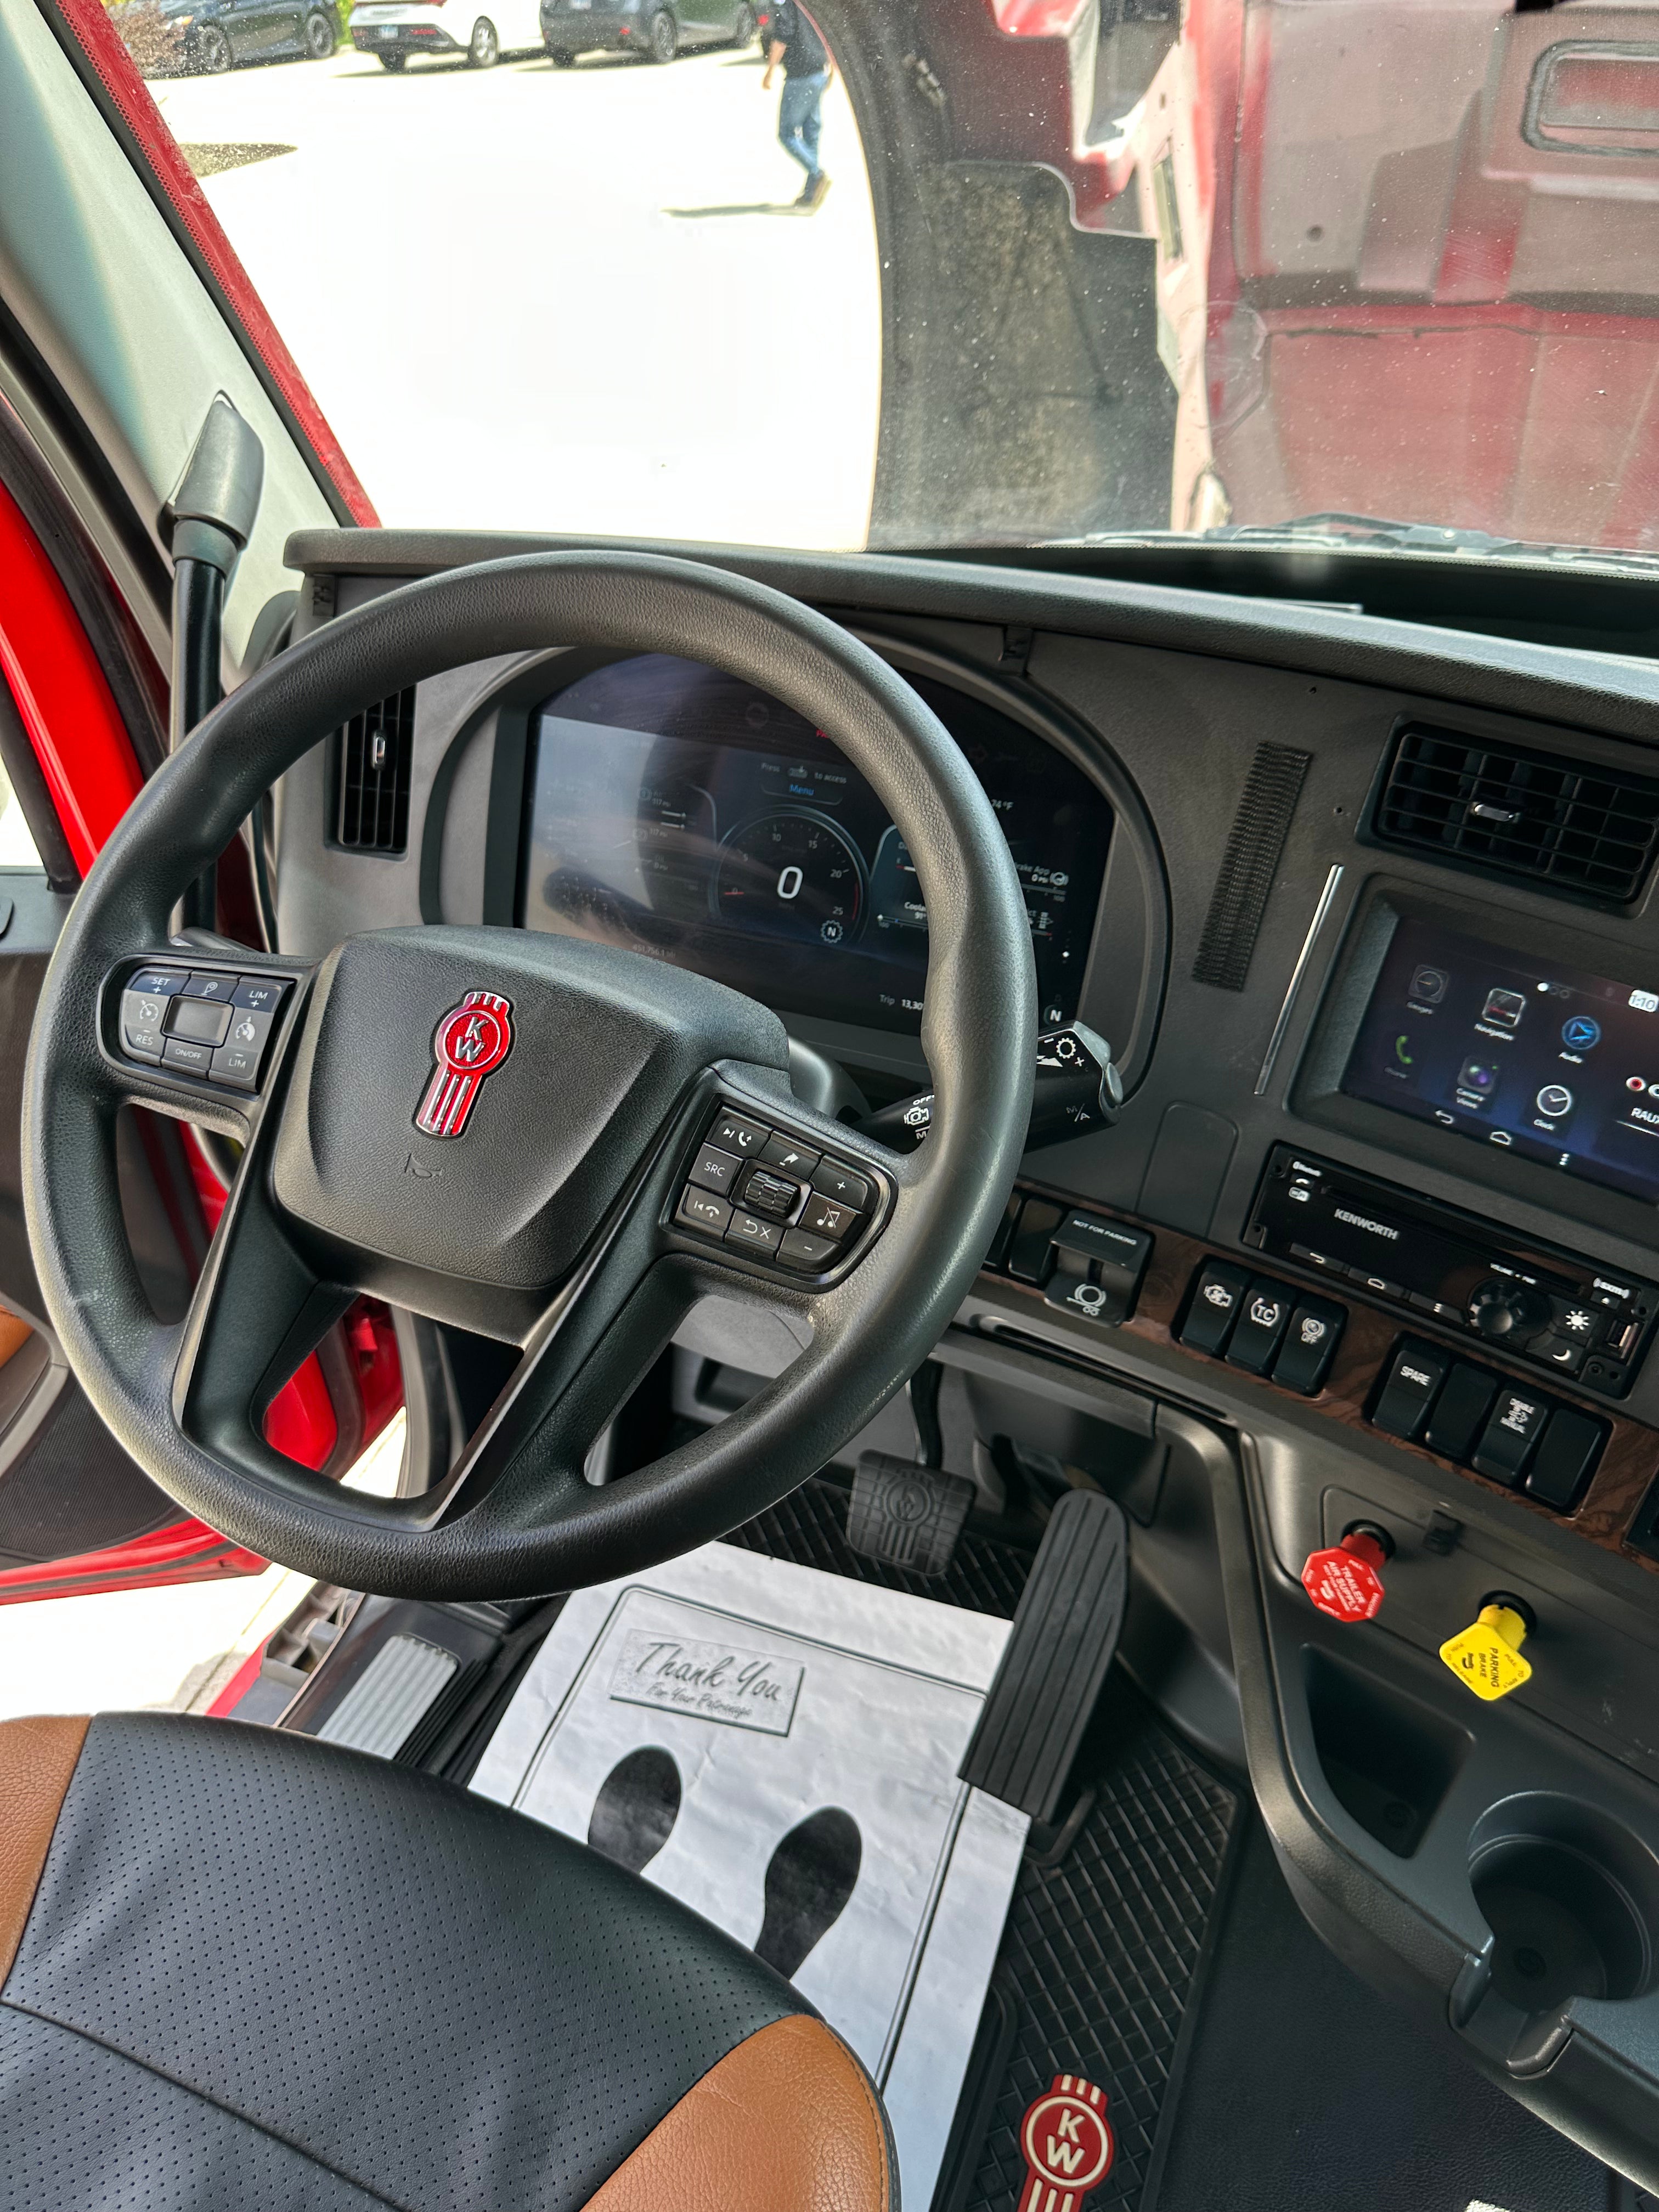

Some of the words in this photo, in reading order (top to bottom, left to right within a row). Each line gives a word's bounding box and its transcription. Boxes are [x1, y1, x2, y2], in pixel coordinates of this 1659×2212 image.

[790, 784, 814, 796] Menu
[772, 833, 781, 842] 10
[808, 840, 818, 849] 15
[830, 868, 843, 878] 20
[1015, 862, 1033, 872] rake
[777, 866, 803, 899] 0
[832, 906, 844, 916] 25
[904, 901, 927, 912] Coola
[827, 927, 837, 937] N
[151, 977, 171, 986] SET
[249, 990, 268, 1000] LIM
[879, 994, 895, 1007] Trip
[901, 998, 924, 1011] 13,30
[1630, 994, 1656, 1011] 1:10
[1050, 1009, 1062, 1022] N
[136, 1035, 154, 1046] RES
[175, 1048, 202, 1059] ON/OFF
[228, 1058, 247, 1069] LIM
[704, 1161, 725, 1177] SRC
[1334, 1208, 1400, 1240] KENWORTH
[1072, 1219, 1090, 1228] NOT
[1088, 1224, 1105, 1234] FOR
[1104, 1230, 1137, 1246] PARKING
[1257, 1305, 1274, 1321] TC
[1400, 1365, 1431, 1386] SPARE
[1327, 1561, 1342, 1577] AIR
[1335, 1577, 1362, 1612] SUPPLY
[1340, 1565, 1367, 1604] TRAILER
[636, 1642, 736, 1688] Thank
[737, 1660, 783, 1701] You
[1479, 1652, 1487, 1678] BRAKE
[1489, 1646, 1500, 1688] PARKING
